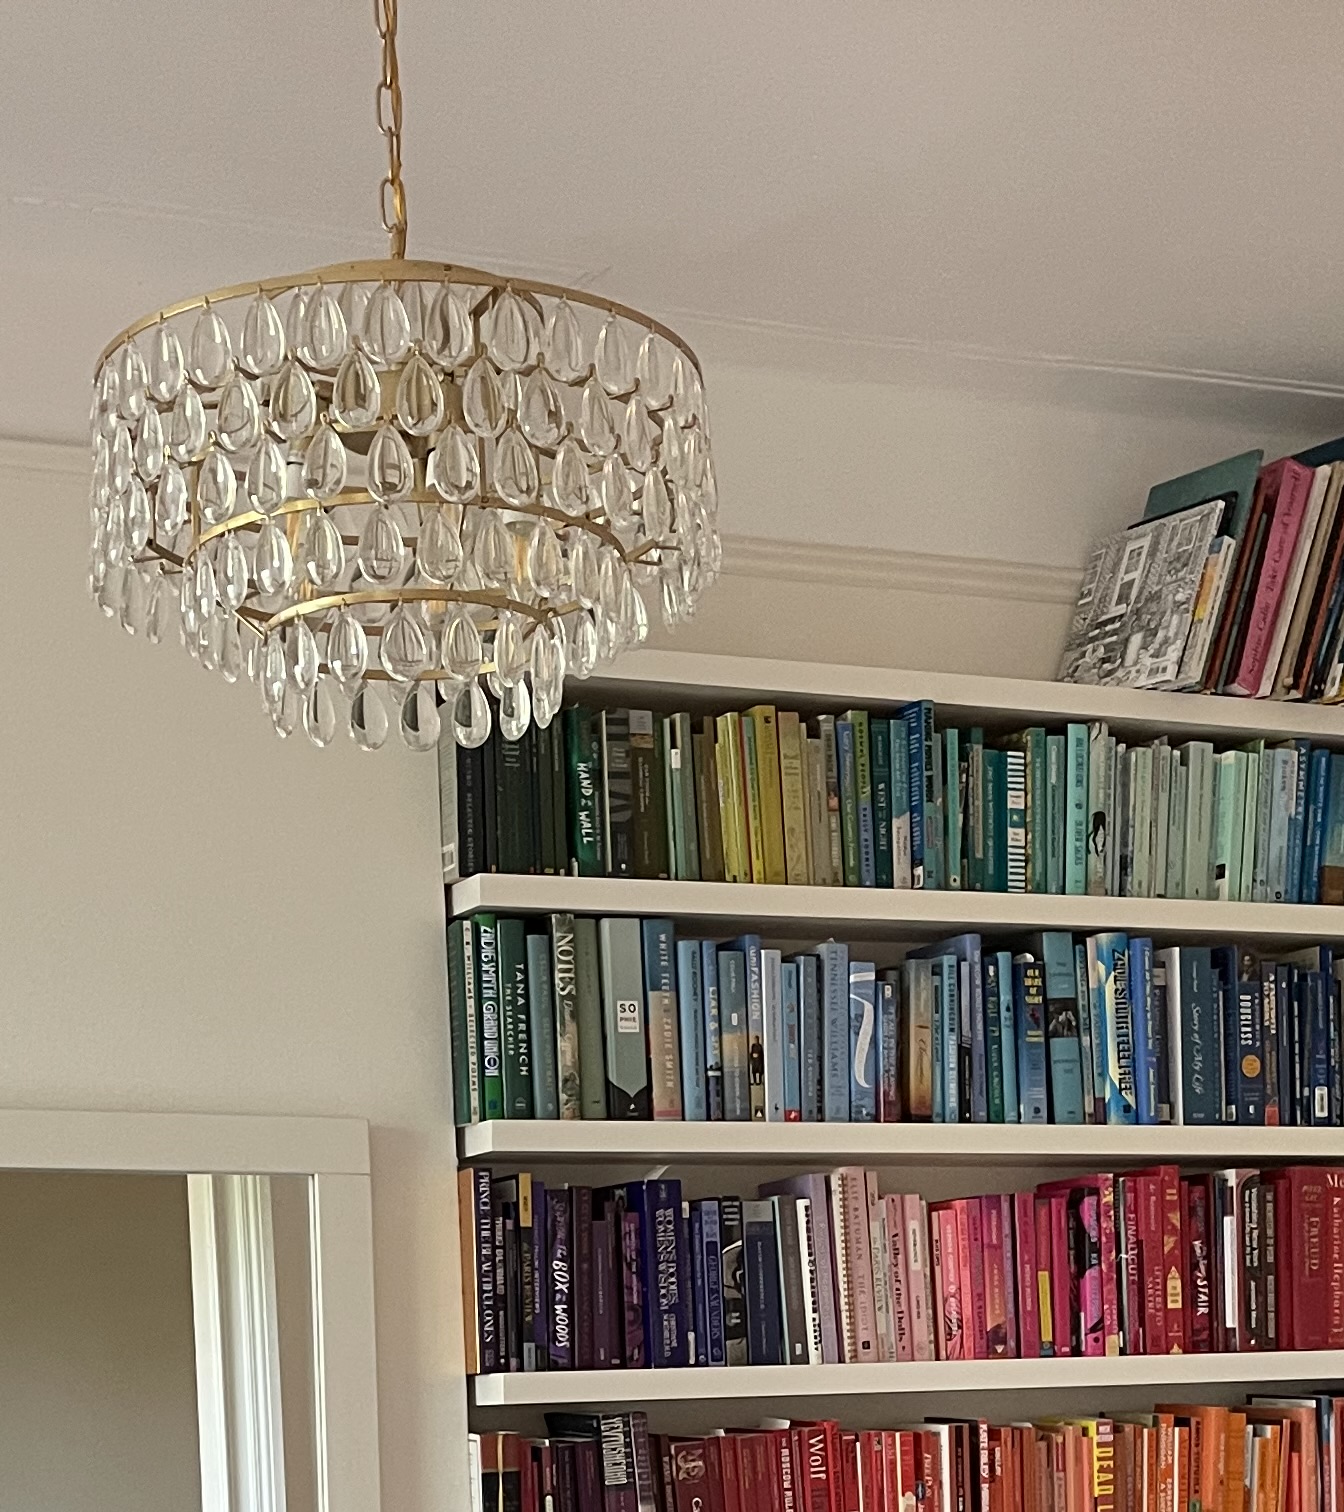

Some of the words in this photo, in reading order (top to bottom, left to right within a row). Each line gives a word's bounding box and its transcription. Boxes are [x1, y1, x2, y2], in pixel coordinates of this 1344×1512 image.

[577, 763, 592, 796] HAND
[579, 811, 593, 844] WALL
[515, 963, 526, 1006] TANA
[556, 932, 576, 996] NOTES
[1191, 1003, 1201, 1030] Story
[1239, 994, 1252, 1046] DOUGLASS
[517, 1014, 529, 1076] FRENCH
[1191, 1074, 1204, 1095] Life
[1309, 1217, 1320, 1271] FREUD
[552, 1260, 569, 1293] BOX
[1128, 1256, 1138, 1281] CUT
[554, 1304, 570, 1348] WOODS
[808, 1434, 826, 1480] Wolf
[1096, 1447, 1114, 1495] DEAD
